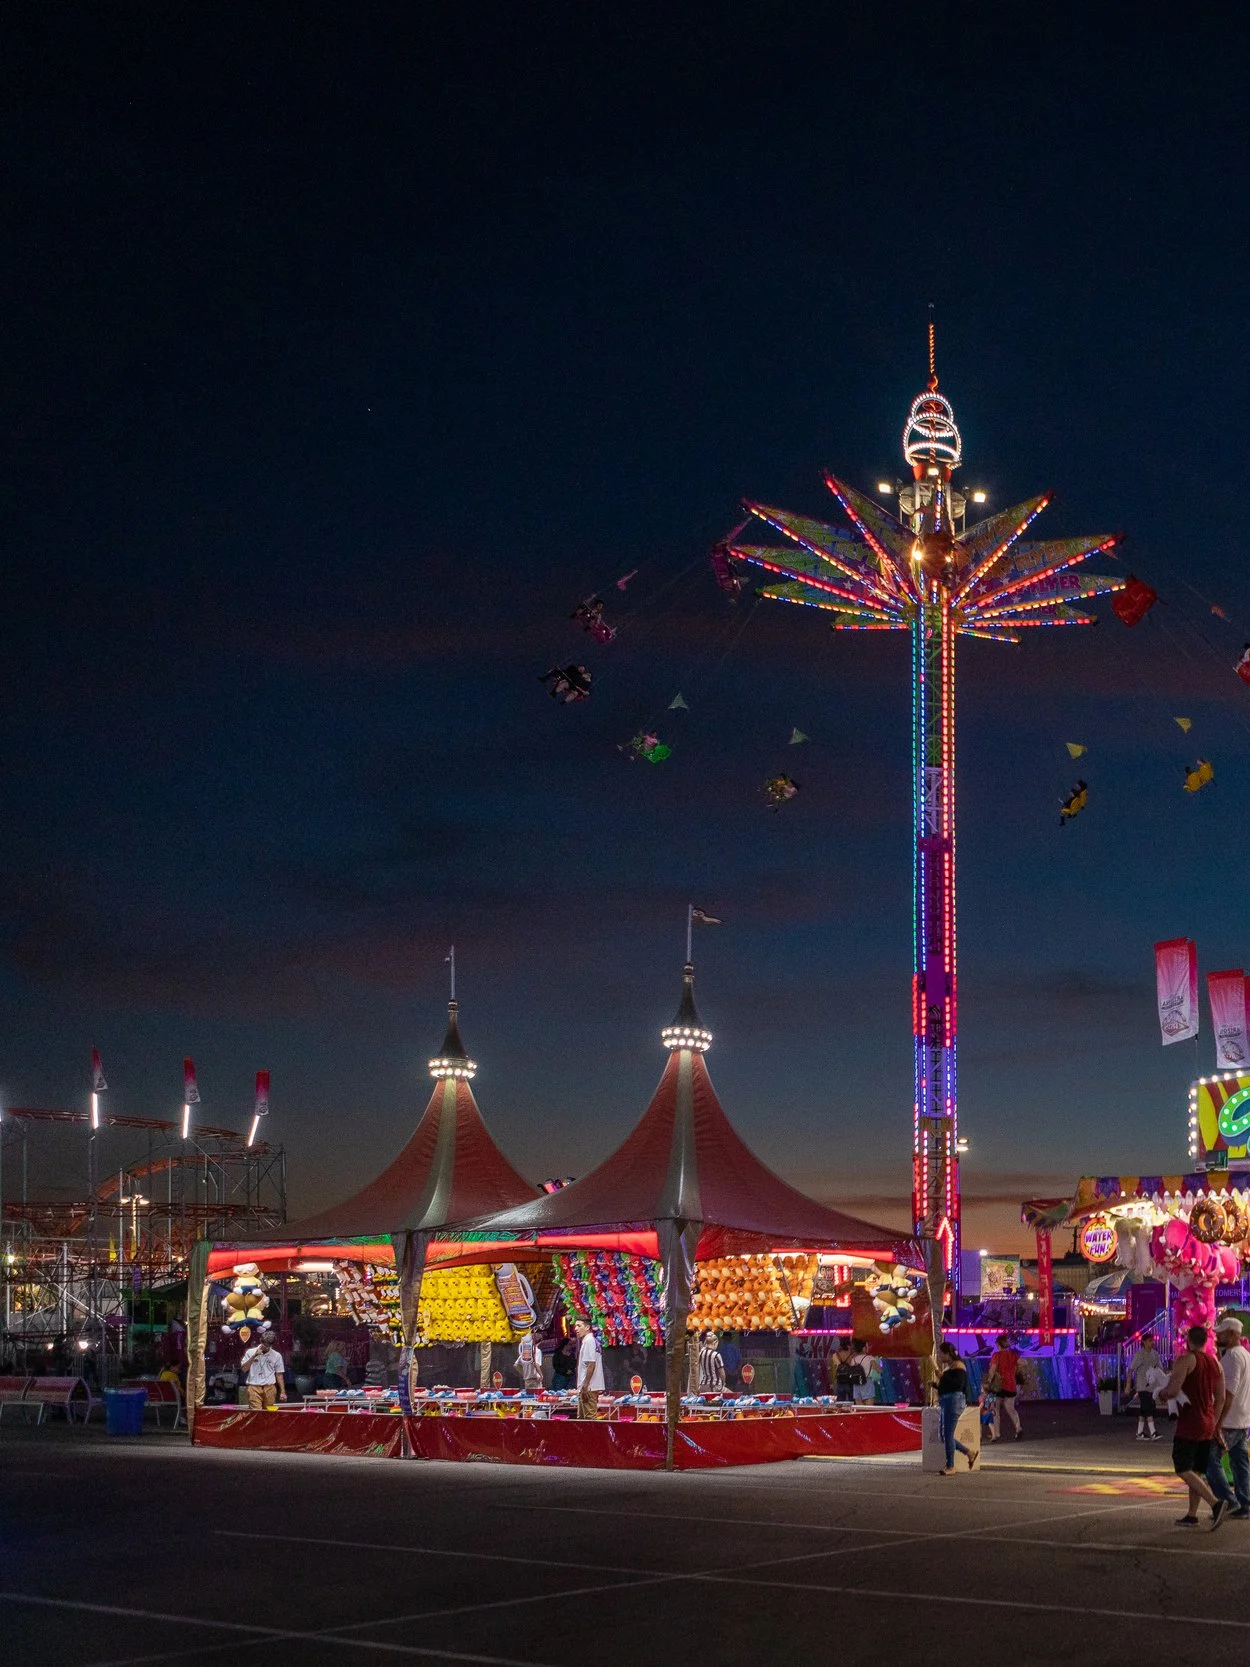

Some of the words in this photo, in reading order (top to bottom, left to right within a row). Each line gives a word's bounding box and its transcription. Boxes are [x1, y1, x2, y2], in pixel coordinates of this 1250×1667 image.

[1085, 1229, 1112, 1243] WATER
[1090, 1243, 1109, 1255] FUN!
[1215, 1288, 1243, 1297] TOMERS
